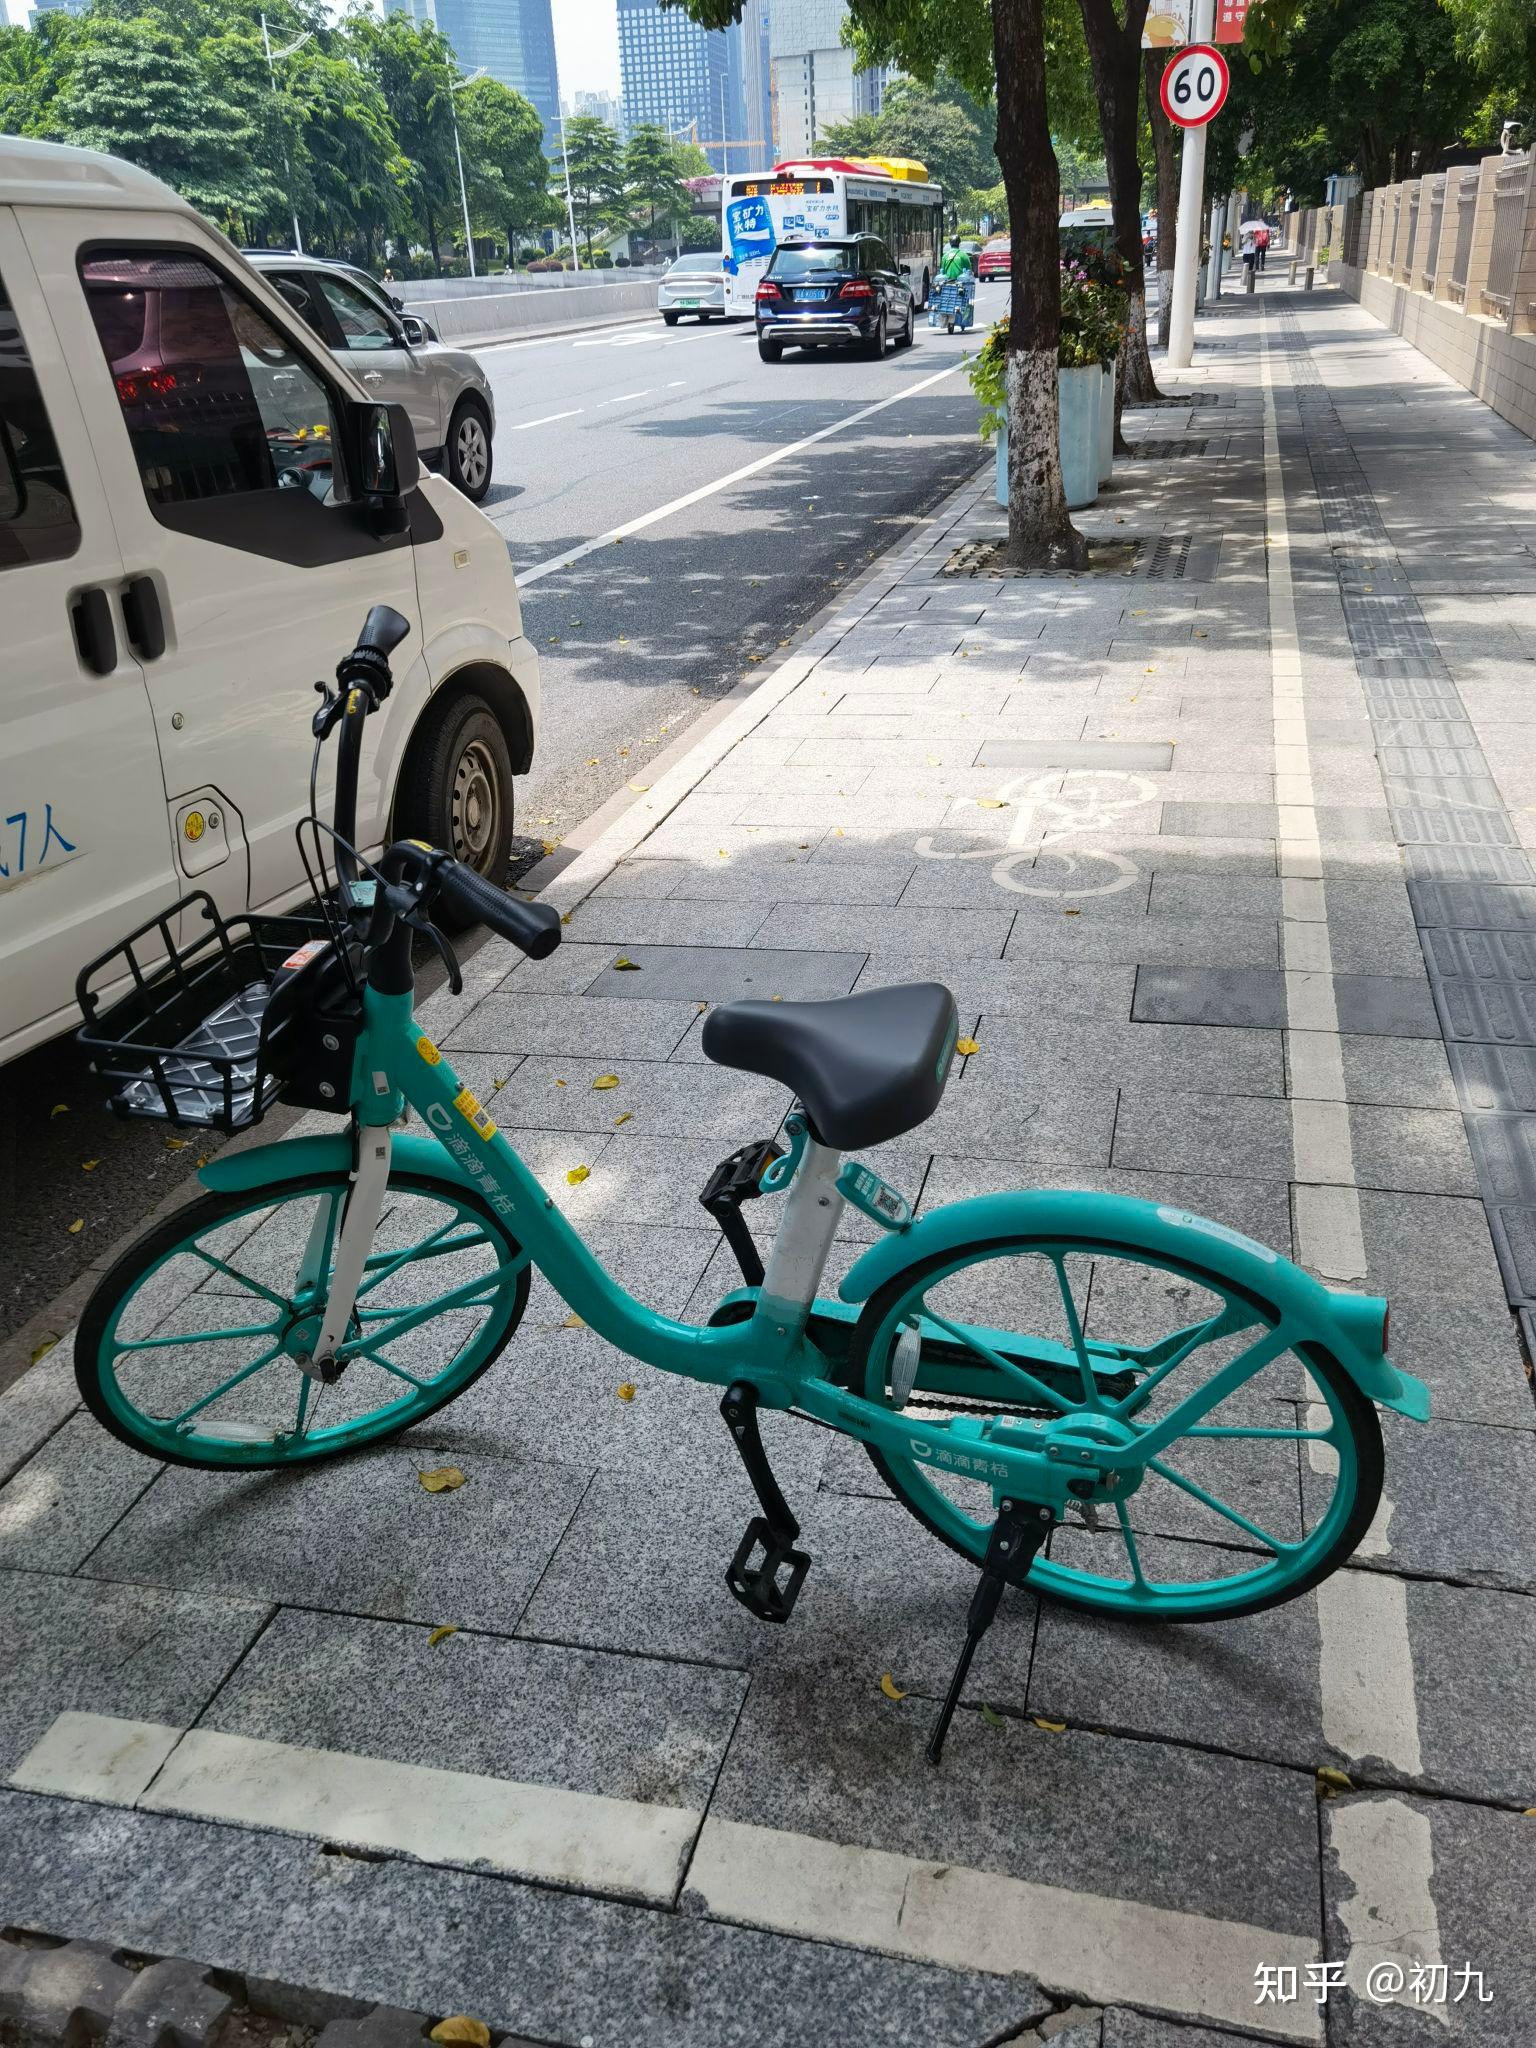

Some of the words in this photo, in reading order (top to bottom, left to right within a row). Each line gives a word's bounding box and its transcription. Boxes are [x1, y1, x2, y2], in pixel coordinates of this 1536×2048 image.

[1174, 67, 1215, 104] 60
[732, 204, 764, 223] 宝矿力
[734, 217, 757, 234] 水特
[0, 803, 77, 877] 7人
[445, 1132, 517, 1216] 滴滴青桔
[936, 1448, 1009, 1478] 滴滴青桔
